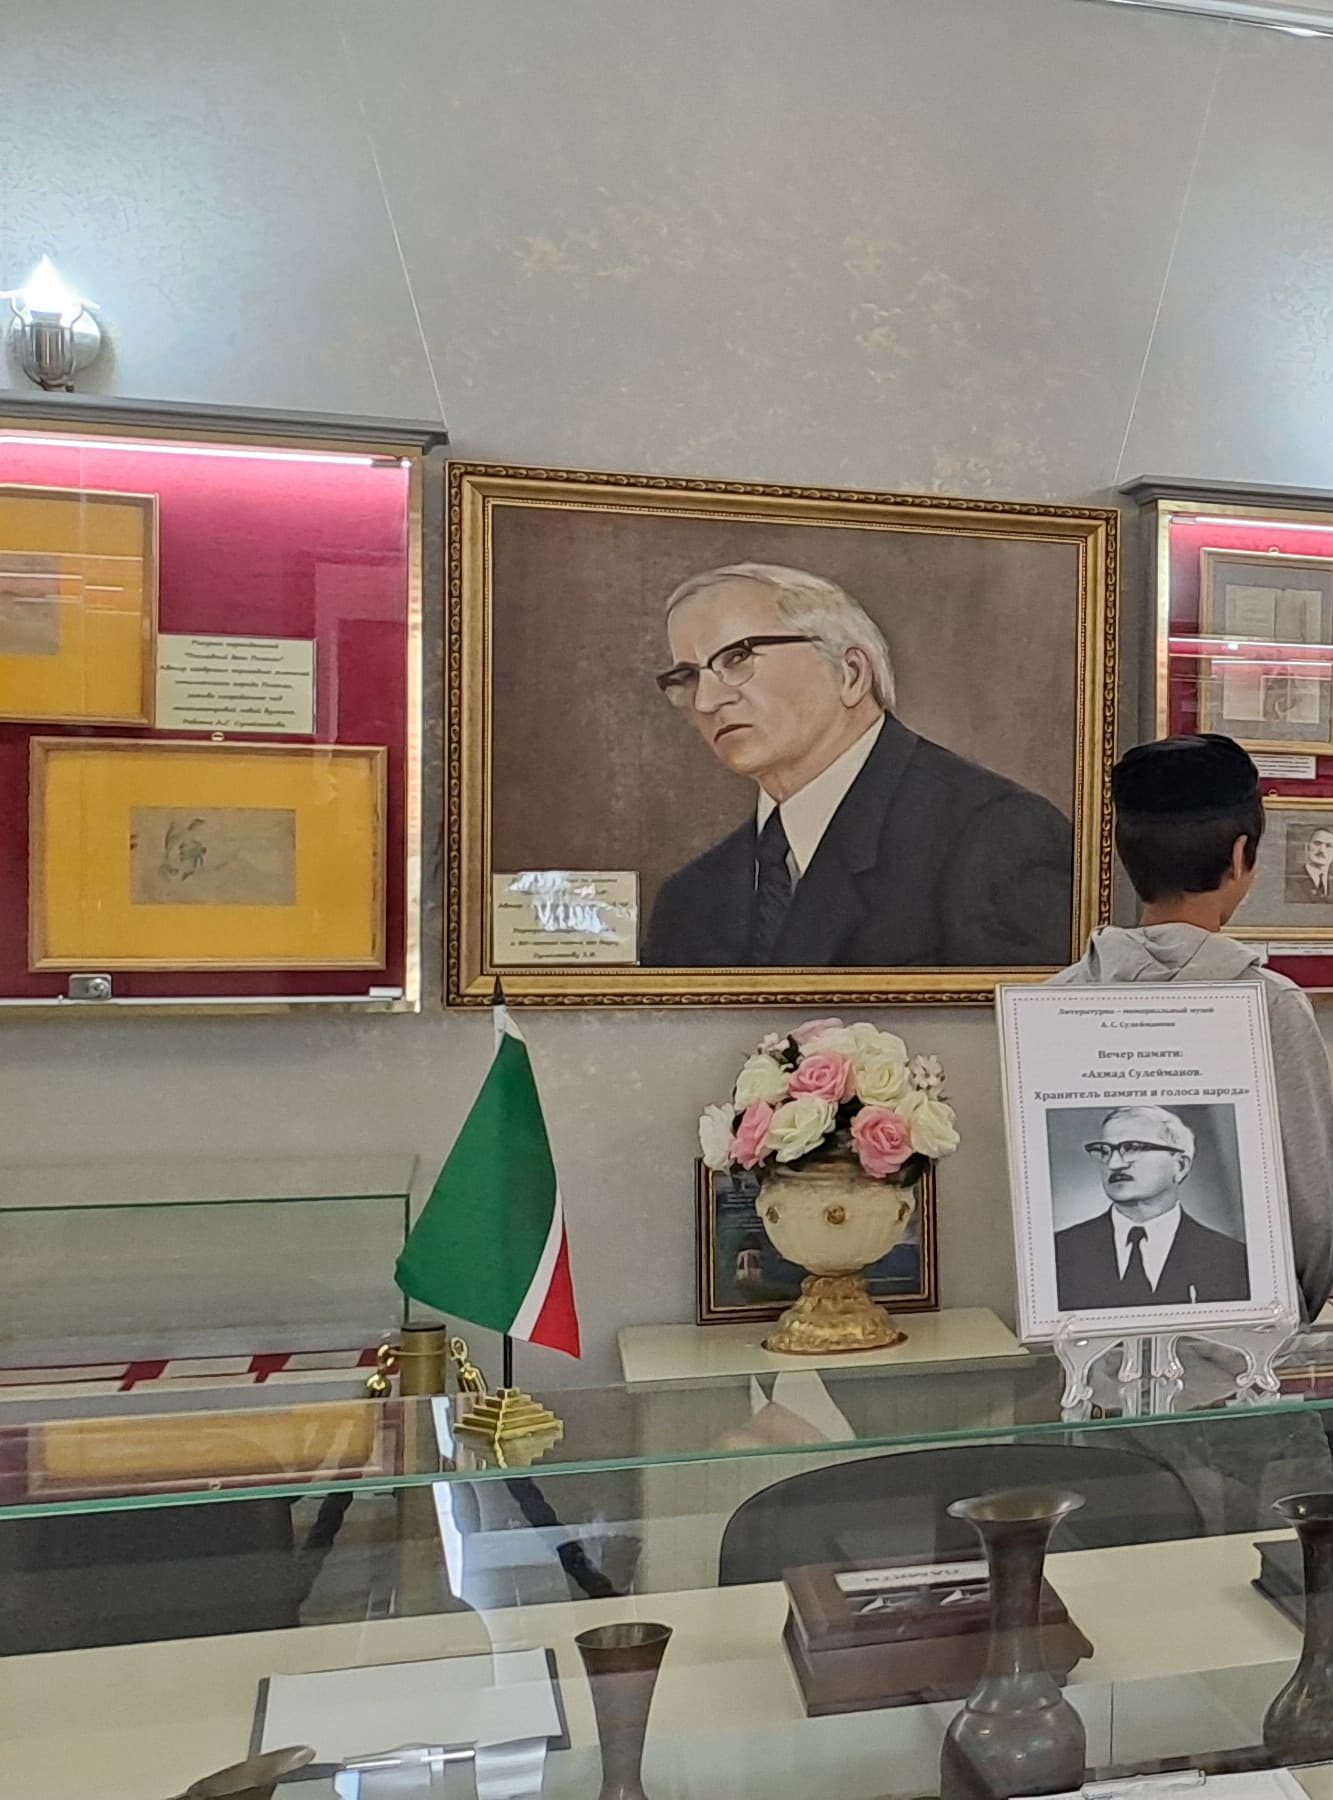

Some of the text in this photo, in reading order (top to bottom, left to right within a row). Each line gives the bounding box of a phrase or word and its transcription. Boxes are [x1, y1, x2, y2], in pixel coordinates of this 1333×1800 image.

[1098, 1050, 1183, 1060] Вечер памяти:
[1081, 1068, 1202, 1079] «Ахмад Сулейманов.
[1034, 1088, 1249, 1102] Хранитель памяти и голоса народа»
